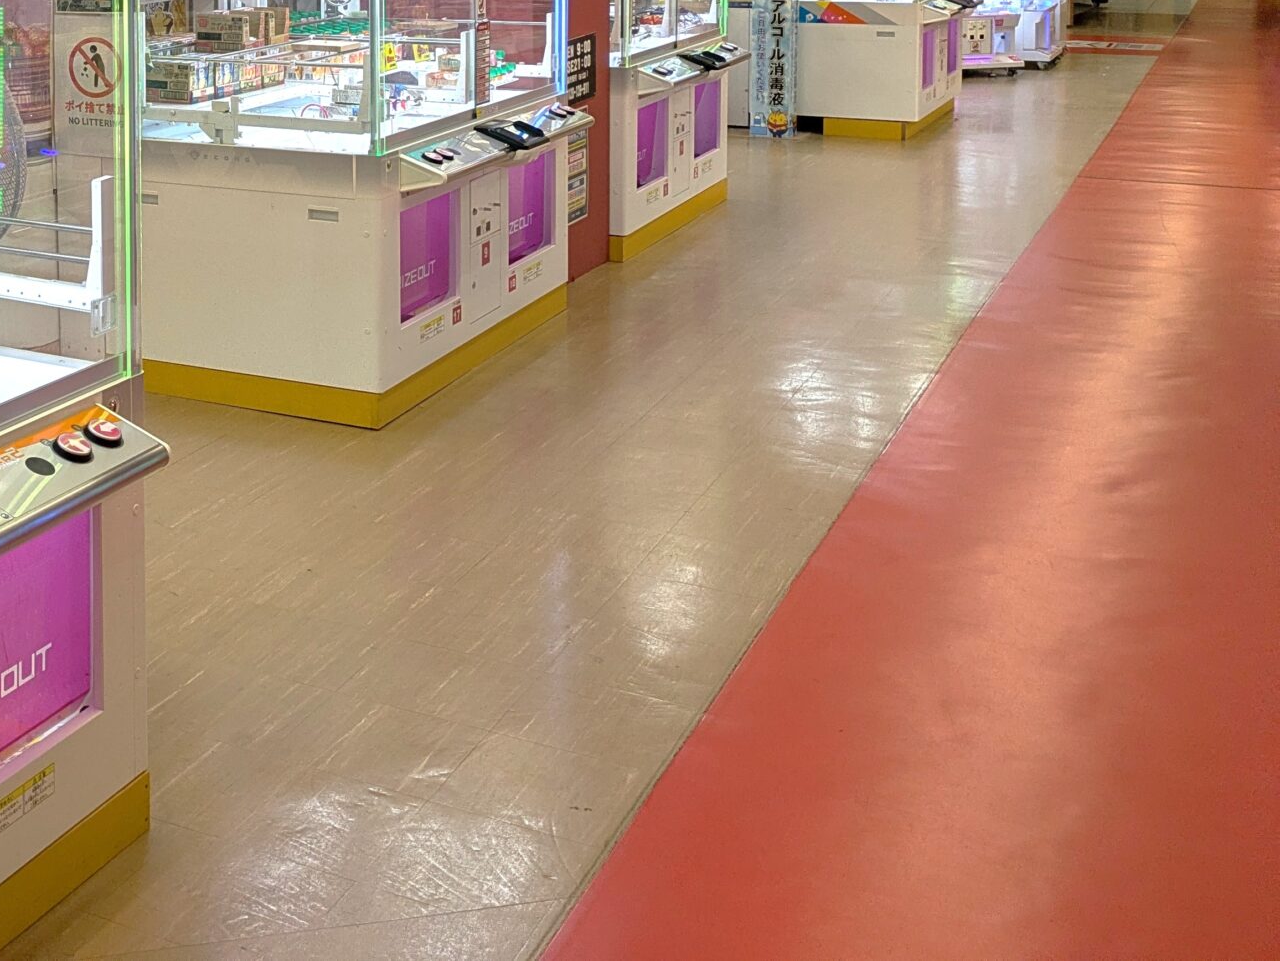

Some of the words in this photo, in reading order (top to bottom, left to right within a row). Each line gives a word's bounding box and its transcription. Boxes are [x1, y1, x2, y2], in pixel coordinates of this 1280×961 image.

[769, 0, 786, 107] アルコール消毒液
[68, 116, 81, 125] NO
